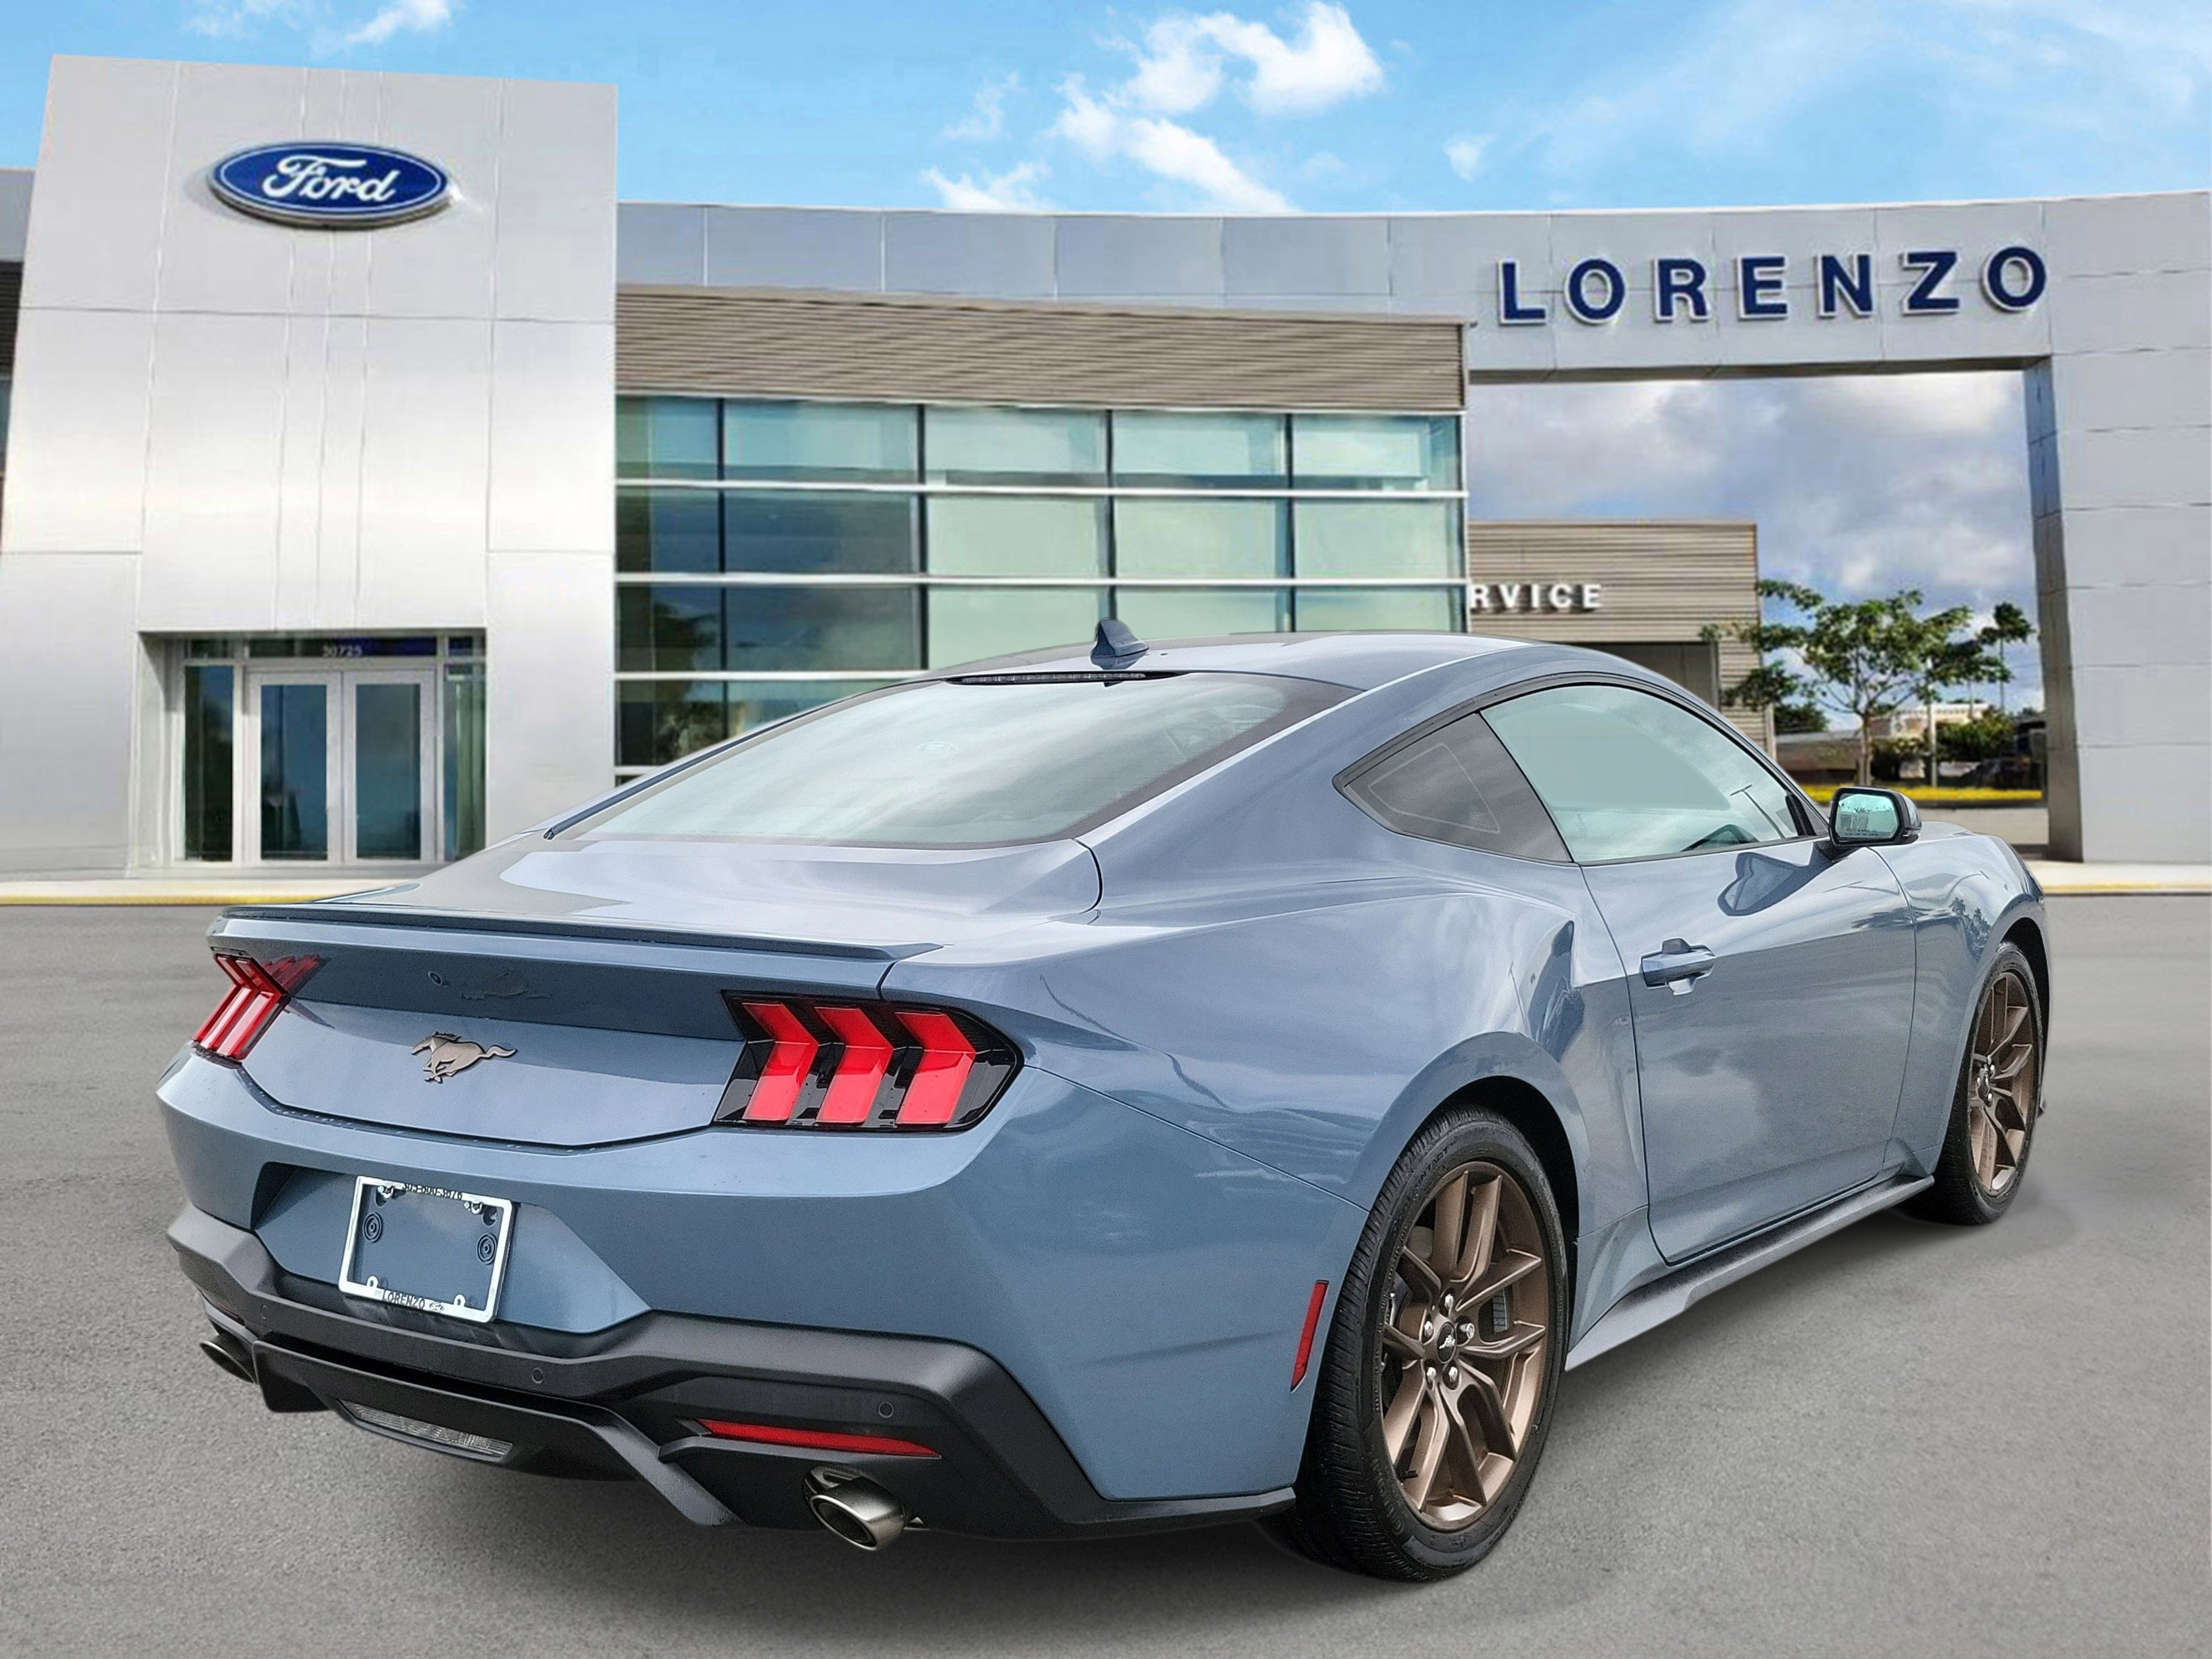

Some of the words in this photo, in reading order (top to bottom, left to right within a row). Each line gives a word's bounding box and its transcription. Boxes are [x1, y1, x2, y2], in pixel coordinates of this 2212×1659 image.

[262, 154, 400, 201] Ford
[1499, 246, 2047, 324] LORENZO
[383, 1290, 425, 1310] LORENZO
